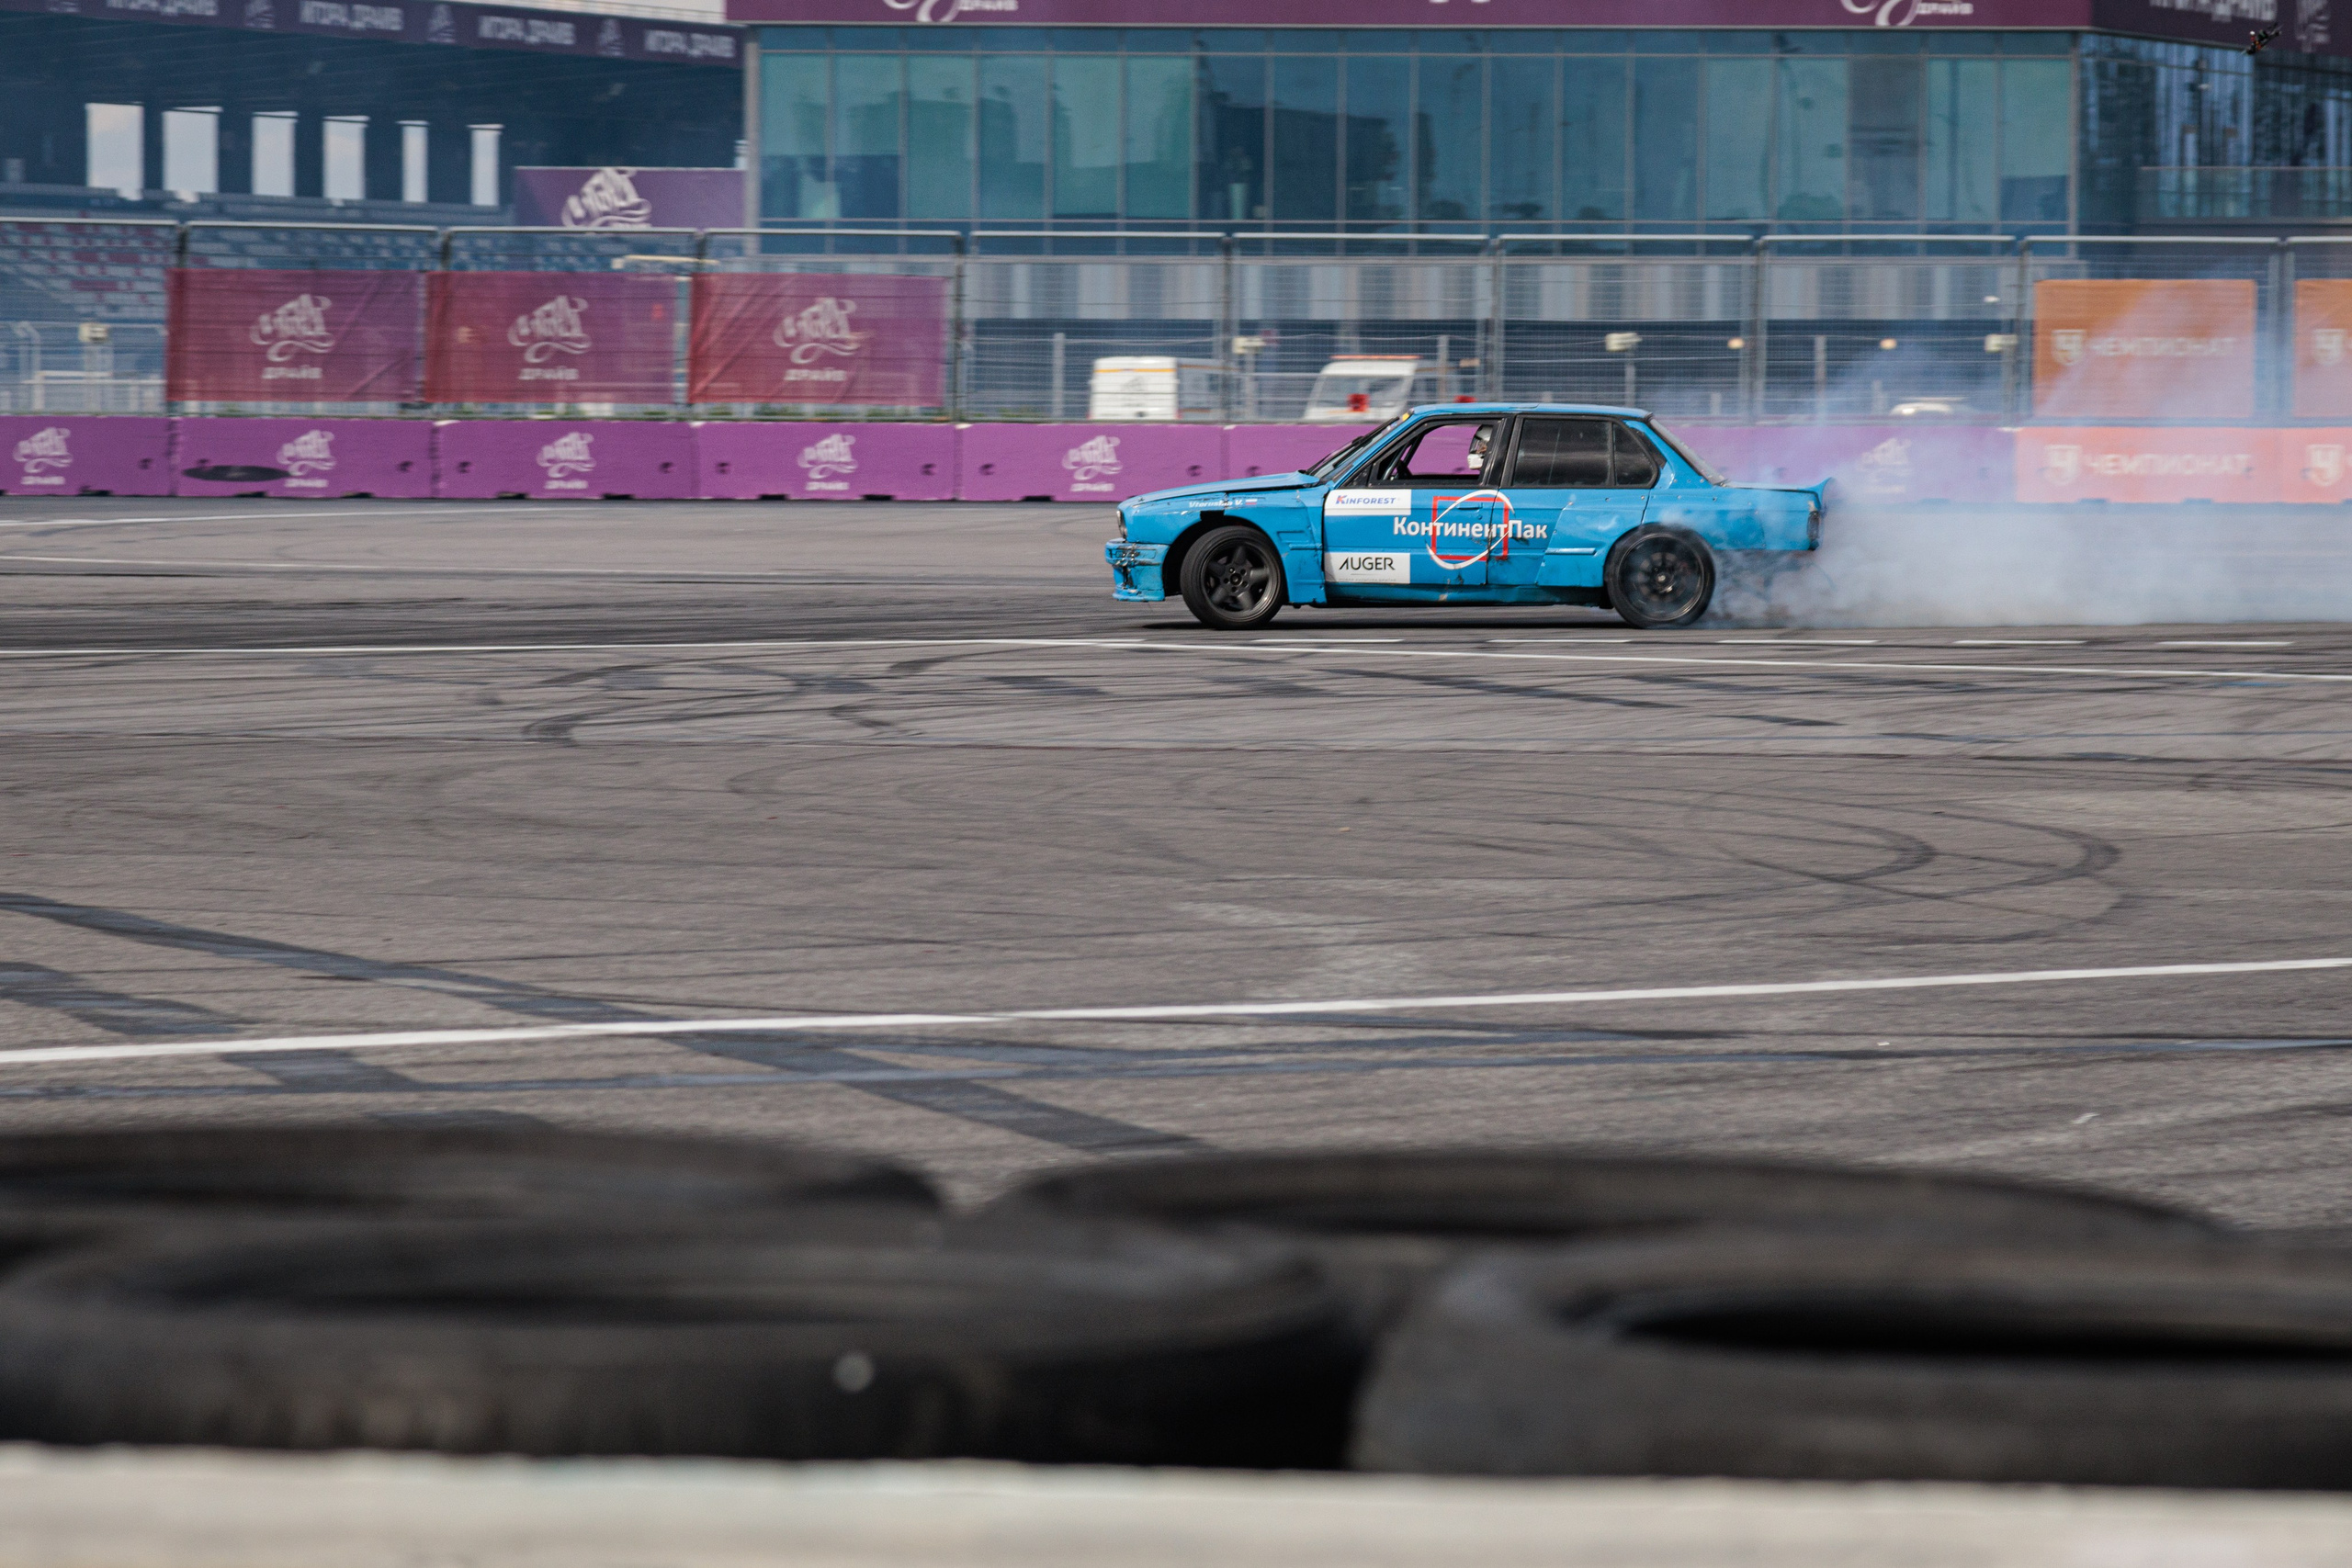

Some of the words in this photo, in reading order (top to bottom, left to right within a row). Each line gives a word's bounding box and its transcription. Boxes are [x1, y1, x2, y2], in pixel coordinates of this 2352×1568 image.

[1336, 494, 1396, 504] KINFOREST
[1394, 516, 1549, 538] КонтинентПак
[1340, 557, 1395, 570] AUGER
